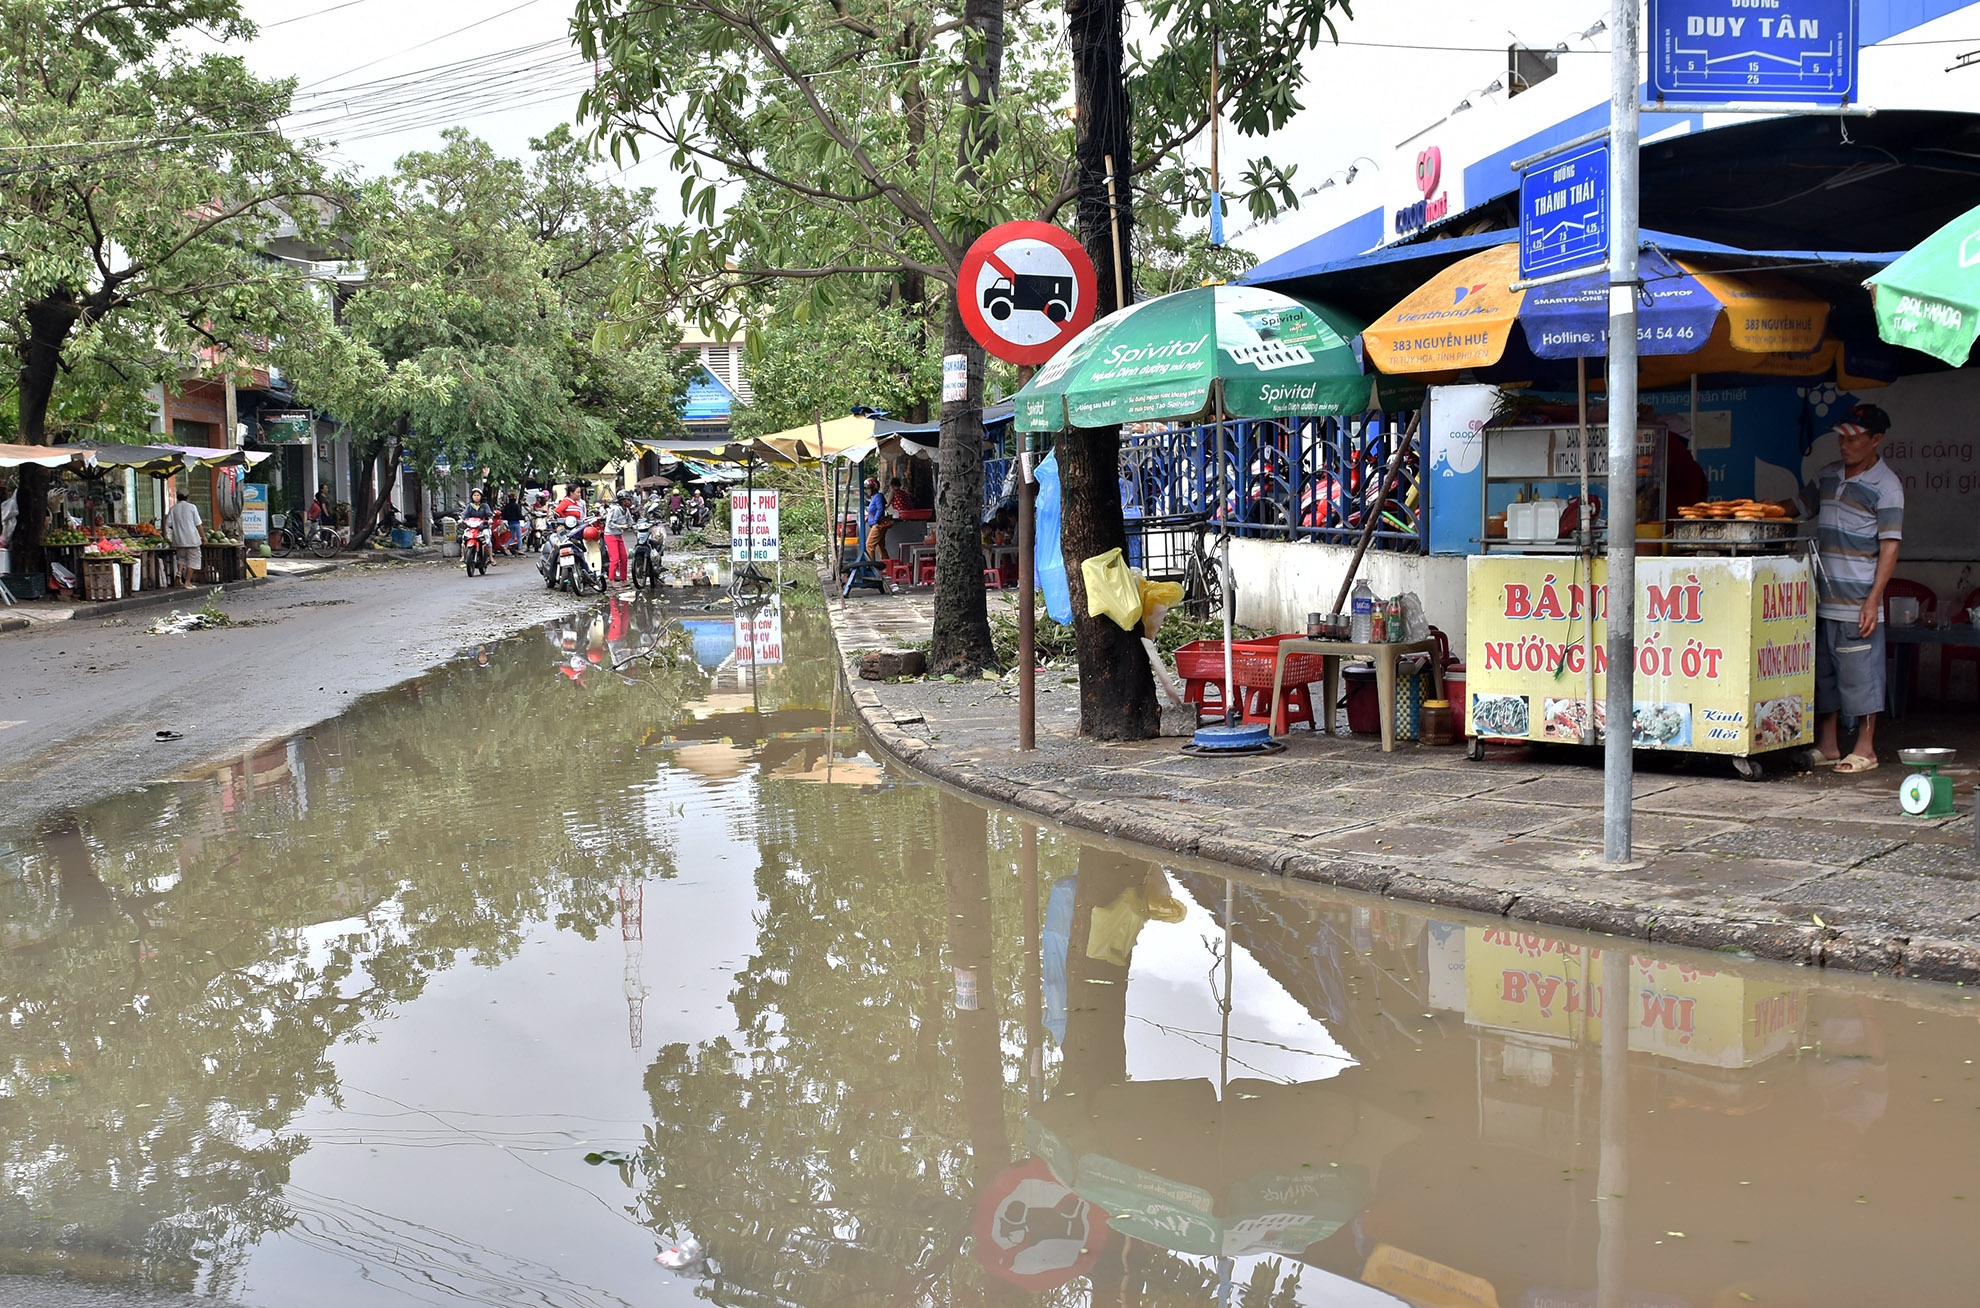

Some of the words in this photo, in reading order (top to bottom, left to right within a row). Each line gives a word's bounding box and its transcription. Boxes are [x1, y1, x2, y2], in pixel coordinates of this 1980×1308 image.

[1687, 16, 1746, 37] DUY
[1758, 14, 1819, 39] TÂN
[1688, 61, 1695, 71] 5
[1749, 62, 1760, 72] 15
[1813, 63, 1820, 73] 5
[1747, 75, 1760, 84] 25
[1534, 190, 1567, 217] THÀNH
[1569, 177, 1595, 206] THÁI
[1534, 295, 1603, 305] SMARTPHONE
[1261, 311, 1304, 326] Spivital
[1745, 319, 1759, 330] 383
[1543, 331, 1594, 345] Hotline:
[1656, 327, 1673, 340] 54
[1676, 326, 1694, 339] 46
[1392, 340, 1412, 352] 383
[1414, 331, 1461, 350] NGUYỄN
[1464, 332, 1489, 347] HUỆ
[1103, 334, 1209, 368] Spivital
[1259, 382, 1316, 404] Spivital
[1721, 387, 1747, 400] thiết
[1167, 400, 1195, 409] Spirulina
[1883, 442, 1914, 459] đãi
[759, 490, 776, 509] PHỞ
[756, 525, 770, 535] CUA
[754, 550, 768, 559] HEO
[1503, 574, 1608, 621] BÁN
[1646, 574, 1704, 623] MÌ
[1762, 573, 1793, 622] BÁNH
[1795, 570, 1808, 618] MÌ
[1484, 634, 1585, 673] NƯỚNG
[1681, 638, 1724, 679] ỚT
